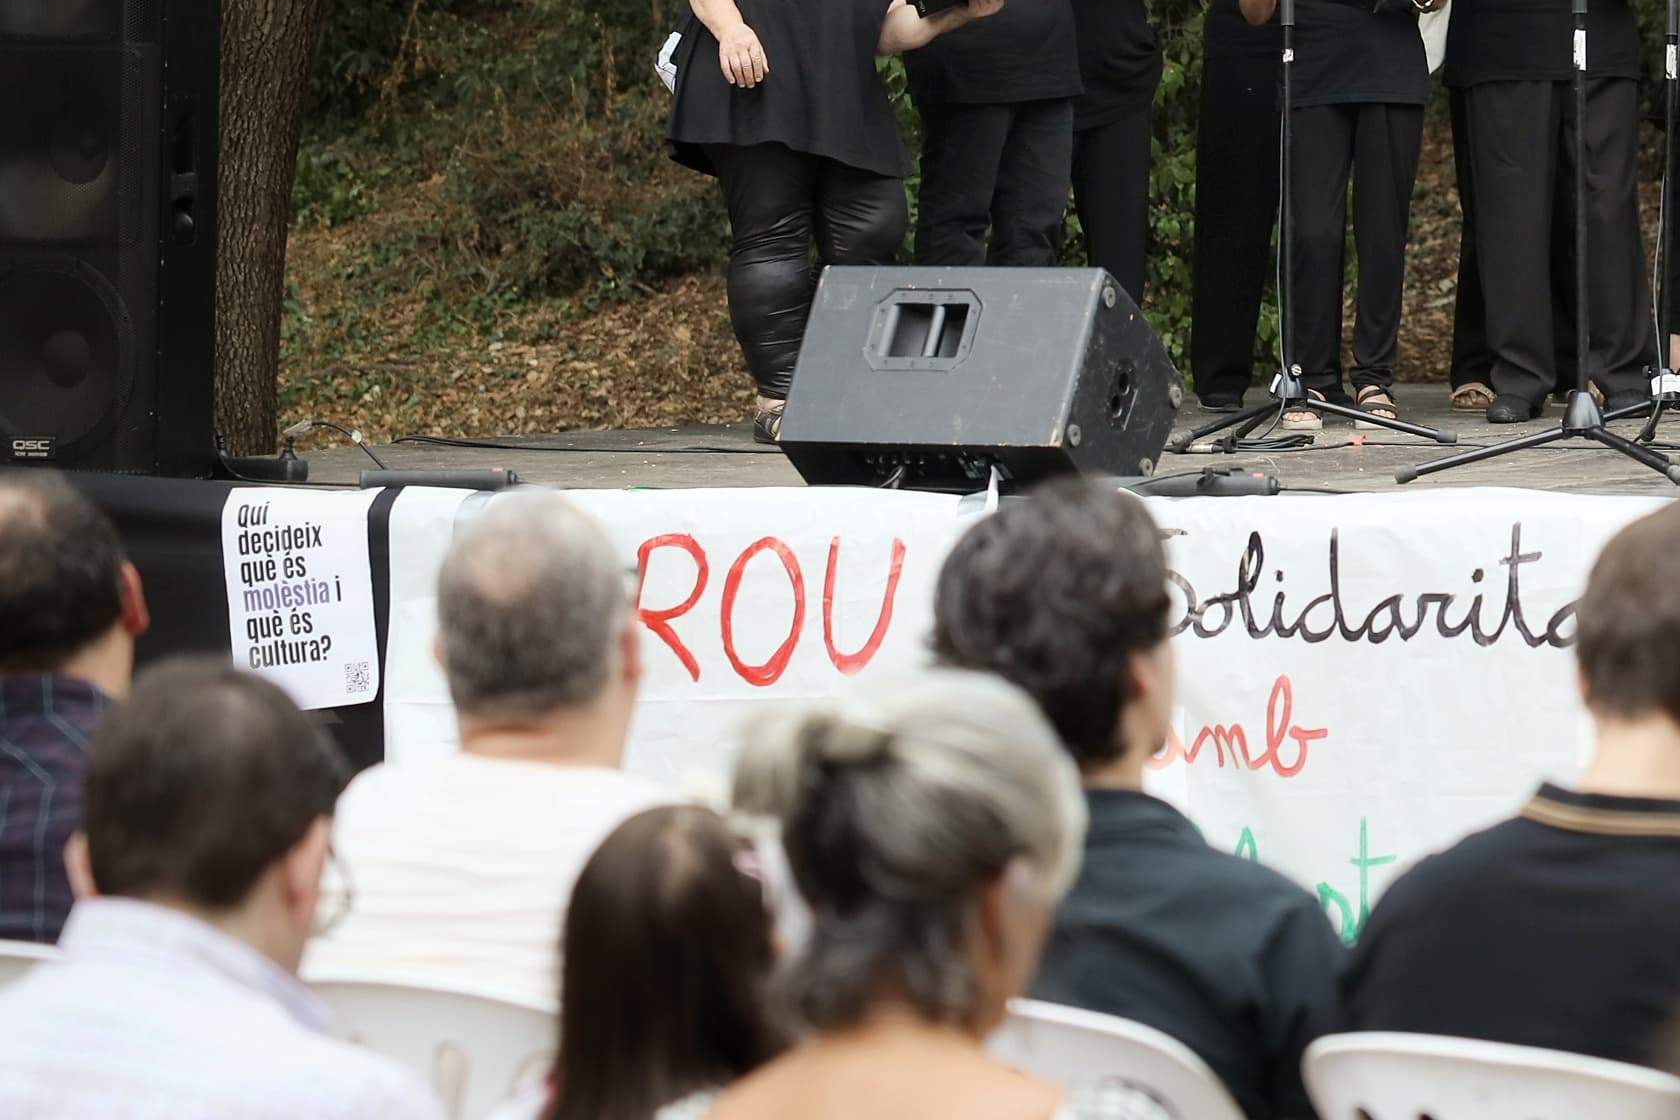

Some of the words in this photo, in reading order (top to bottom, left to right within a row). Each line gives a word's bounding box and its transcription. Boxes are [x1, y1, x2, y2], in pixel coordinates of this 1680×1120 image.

[12, 440, 50, 450] QSC
[238, 522, 323, 556] decideix
[241, 554, 277, 588] què
[283, 552, 307, 579] és
[243, 578, 330, 612] molèstia
[335, 576, 342, 602] i
[633, 533, 906, 687] ROU
[247, 610, 283, 643] què
[290, 607, 313, 635] és
[249, 635, 332, 669] cultura?
